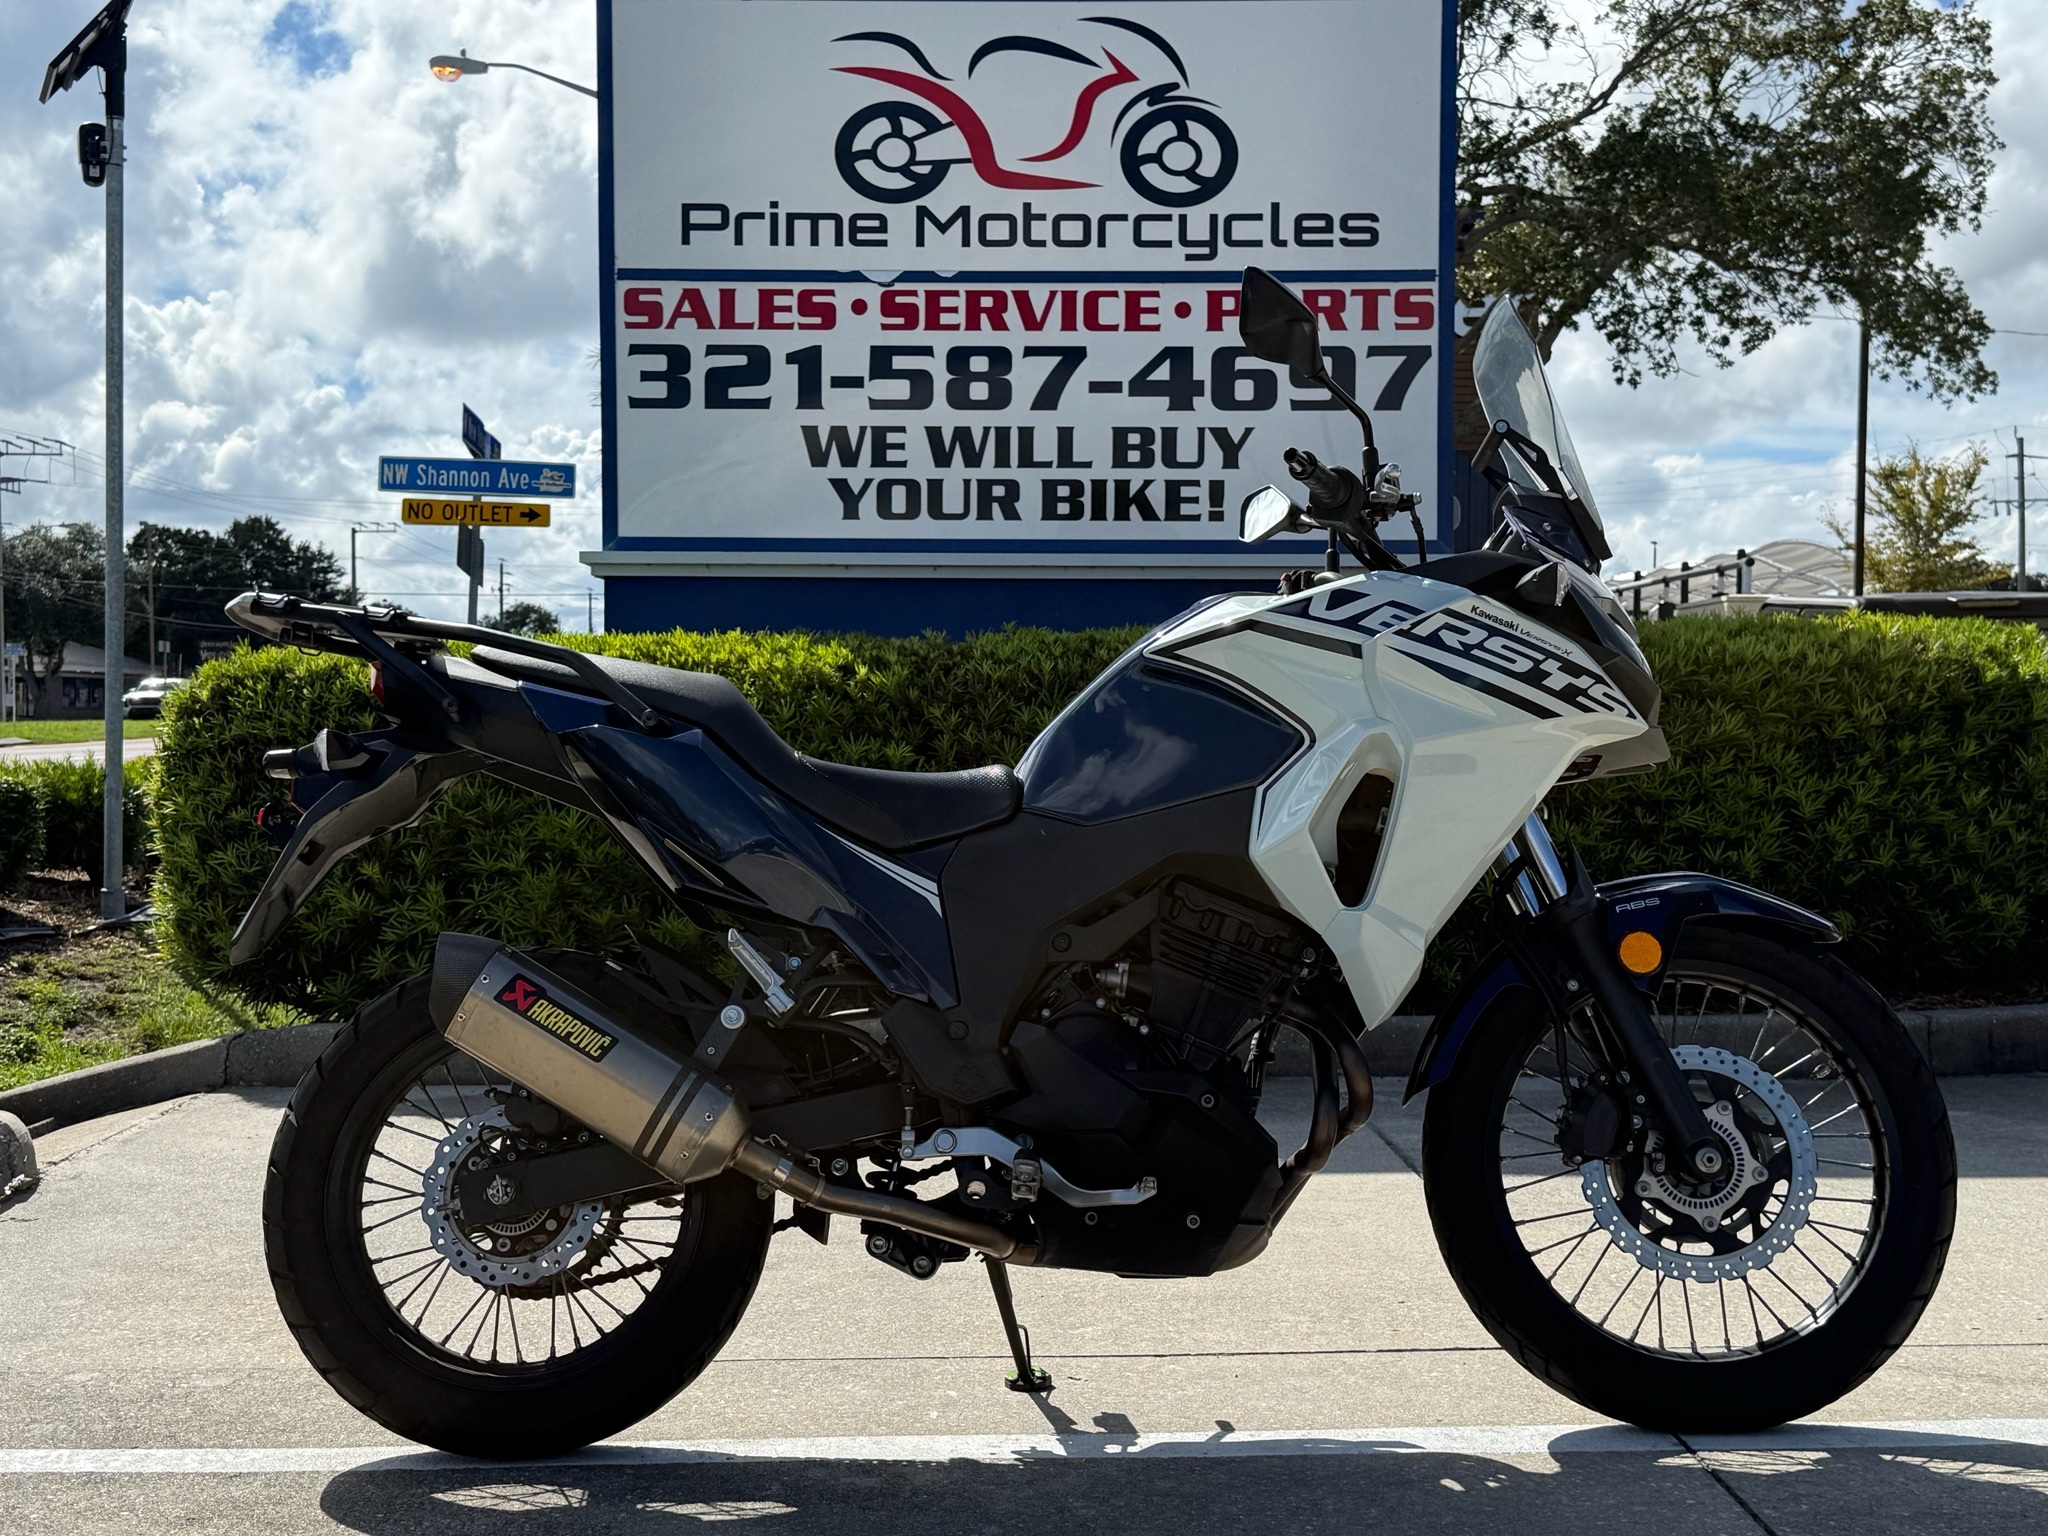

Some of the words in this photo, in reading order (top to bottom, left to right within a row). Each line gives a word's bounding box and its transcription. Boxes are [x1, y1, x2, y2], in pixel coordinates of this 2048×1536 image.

[681, 201, 888, 247] Prime
[916, 202, 1380, 261] Motorcycles
[624, 288, 836, 330] SALES
[880, 290, 1161, 332] SERVICE
[1206, 289, 1434, 331] PRTS
[628, 344, 1432, 410] 321-587-4697
[800, 426, 907, 468] WE
[924, 426, 1093, 468] WILL
[1111, 427, 1255, 469] BUY
[383, 463, 409, 485] NW
[416, 463, 490, 488] Shannon
[498, 467, 530, 490] Ave
[408, 502, 433, 520] NO
[442, 503, 513, 523] OUTLET
[828, 478, 1022, 521] YOUR
[1041, 479, 1225, 522] BIKE!
[1470, 604, 1520, 633] Kawasaki
[1308, 588, 1631, 720] VERSYS
[1615, 897, 1661, 913] ABS
